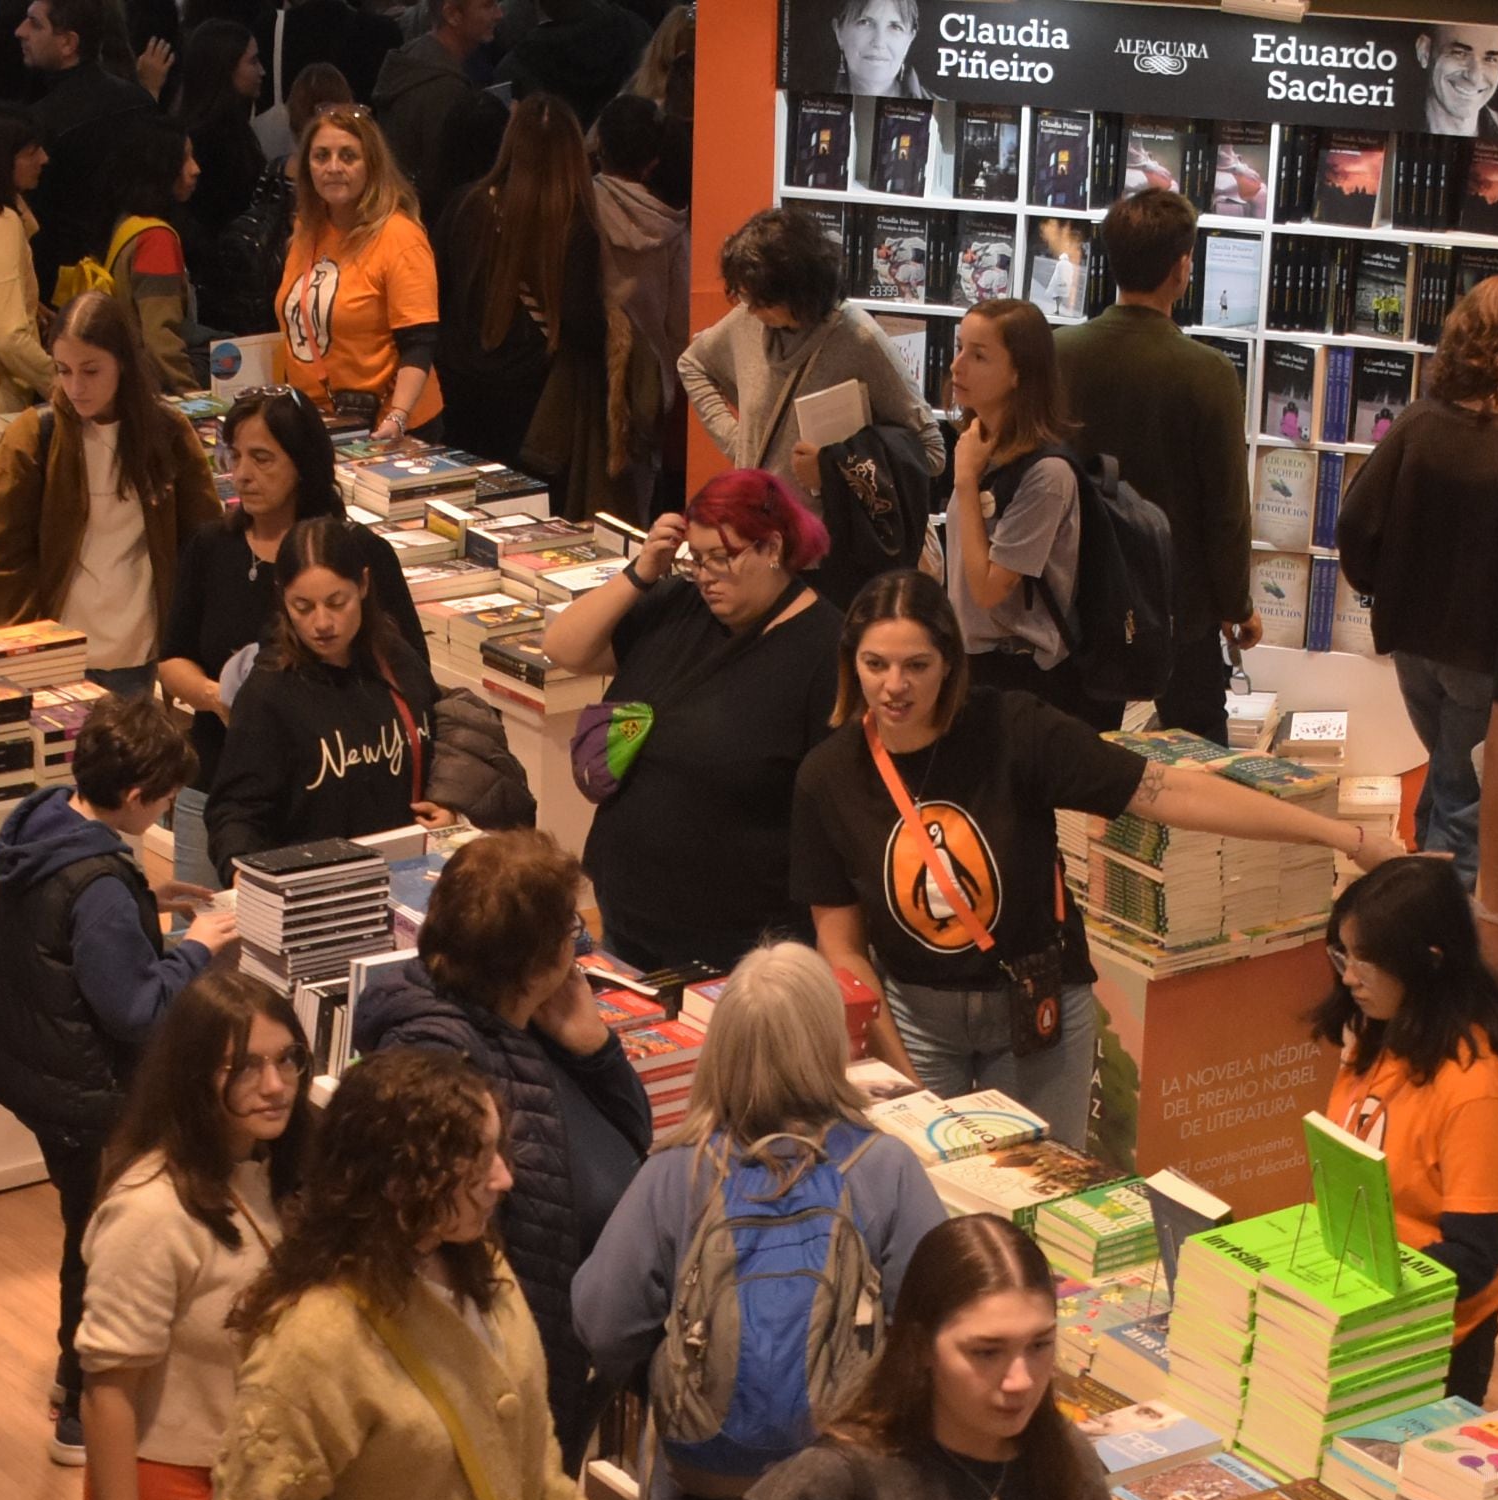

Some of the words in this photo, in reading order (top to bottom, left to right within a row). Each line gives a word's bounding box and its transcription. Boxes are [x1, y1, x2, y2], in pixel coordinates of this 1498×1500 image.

[939, 12, 1071, 50] Claudia
[1113, 37, 1210, 60] ALFAGUARA
[936, 47, 1055, 85] Piñeiro
[1251, 32, 1399, 72] Eduardo
[1266, 69, 1396, 109] Sacheri
[1264, 456, 1307, 469] EDUARDO
[1254, 501, 1309, 518] REVOLUCIÓN
[1161, 1076, 1182, 1097] LA
[1185, 1057, 1255, 1090] NOVELA
[1259, 1040, 1323, 1071] INÉDITA
[1163, 1098, 1193, 1121] DEL
[1196, 1080, 1260, 1111] PREMIO
[1262, 1064, 1318, 1095] NOBEL
[1180, 1118, 1203, 1140] DE
[1205, 1094, 1298, 1133] LITERATURA
[1194, 1135, 1294, 1173] acontecimiento
[1217, 1166, 1238, 1188] de
[1239, 1164, 1254, 1183] la
[1256, 1149, 1307, 1178] década
[1119, 1432, 1169, 1456] PEP
